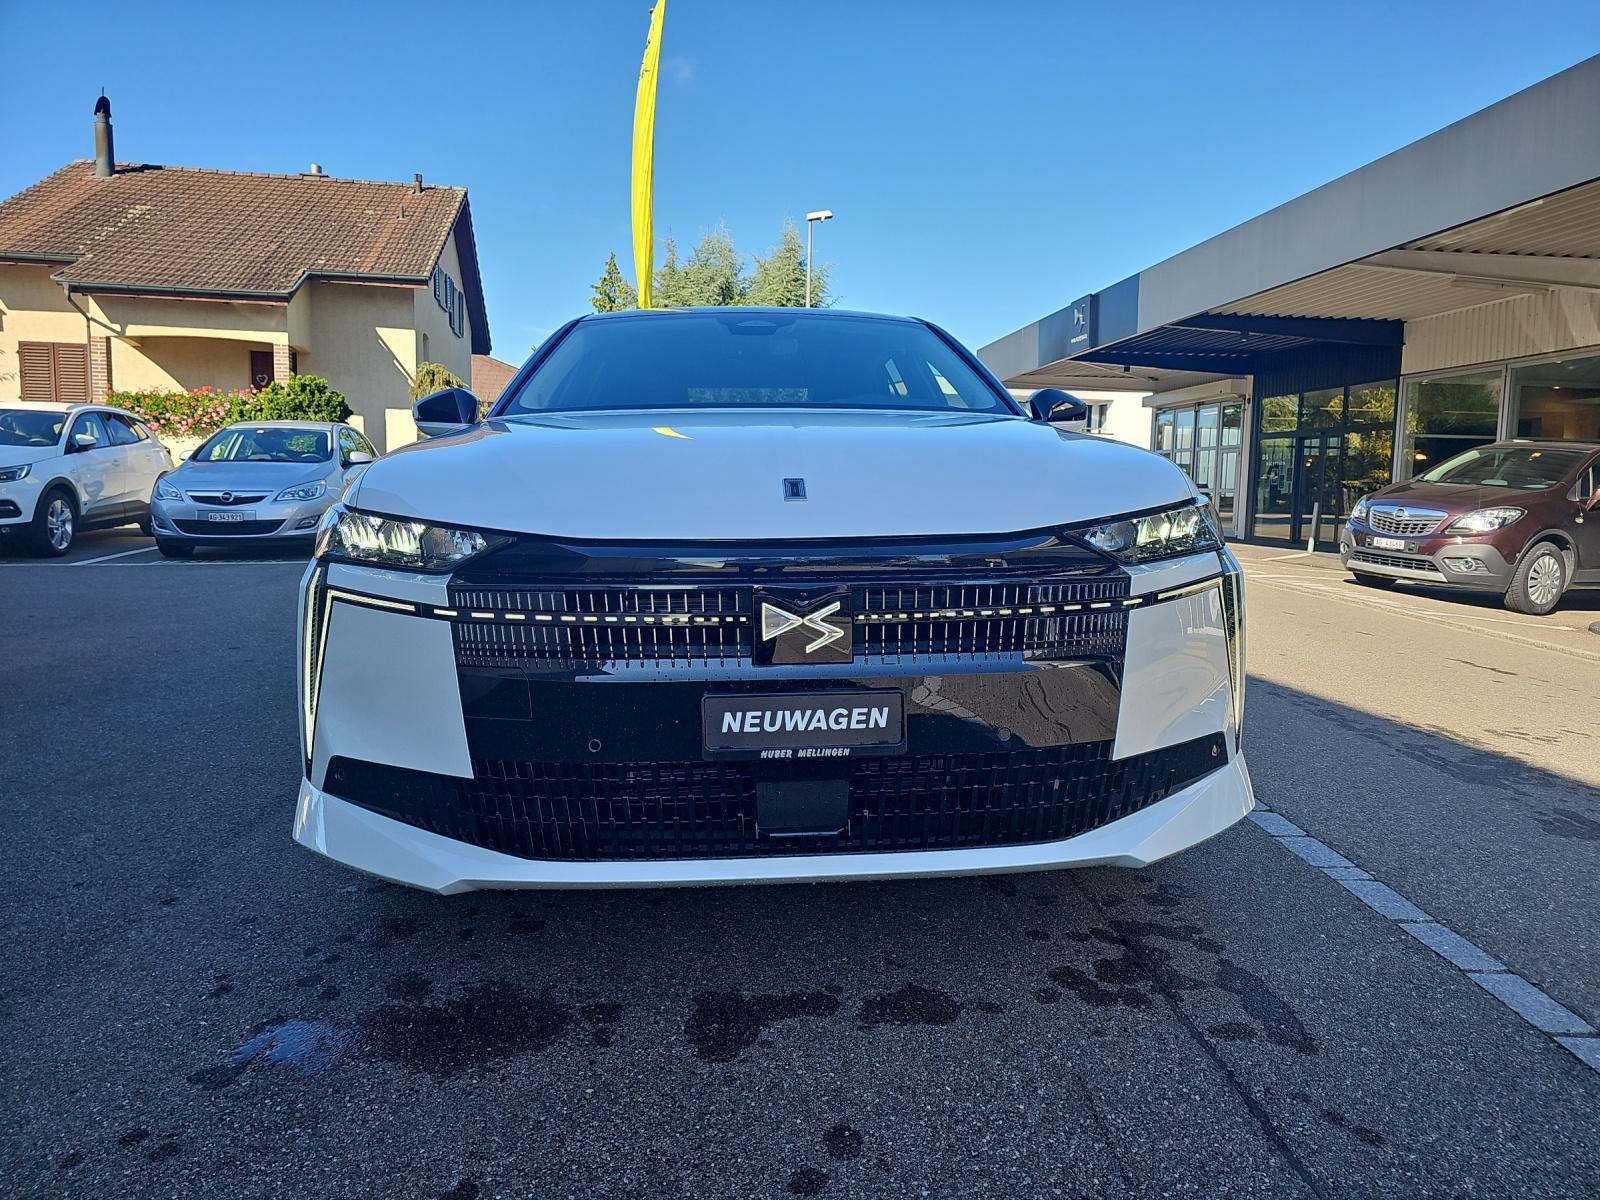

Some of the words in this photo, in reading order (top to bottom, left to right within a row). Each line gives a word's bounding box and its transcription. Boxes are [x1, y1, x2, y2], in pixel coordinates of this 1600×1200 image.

[762, 601, 844, 653] DS
[721, 707, 888, 733] NEUWAGEN
[760, 749, 792, 759] HUBER
[797, 748, 850, 758] MELLINGEN
